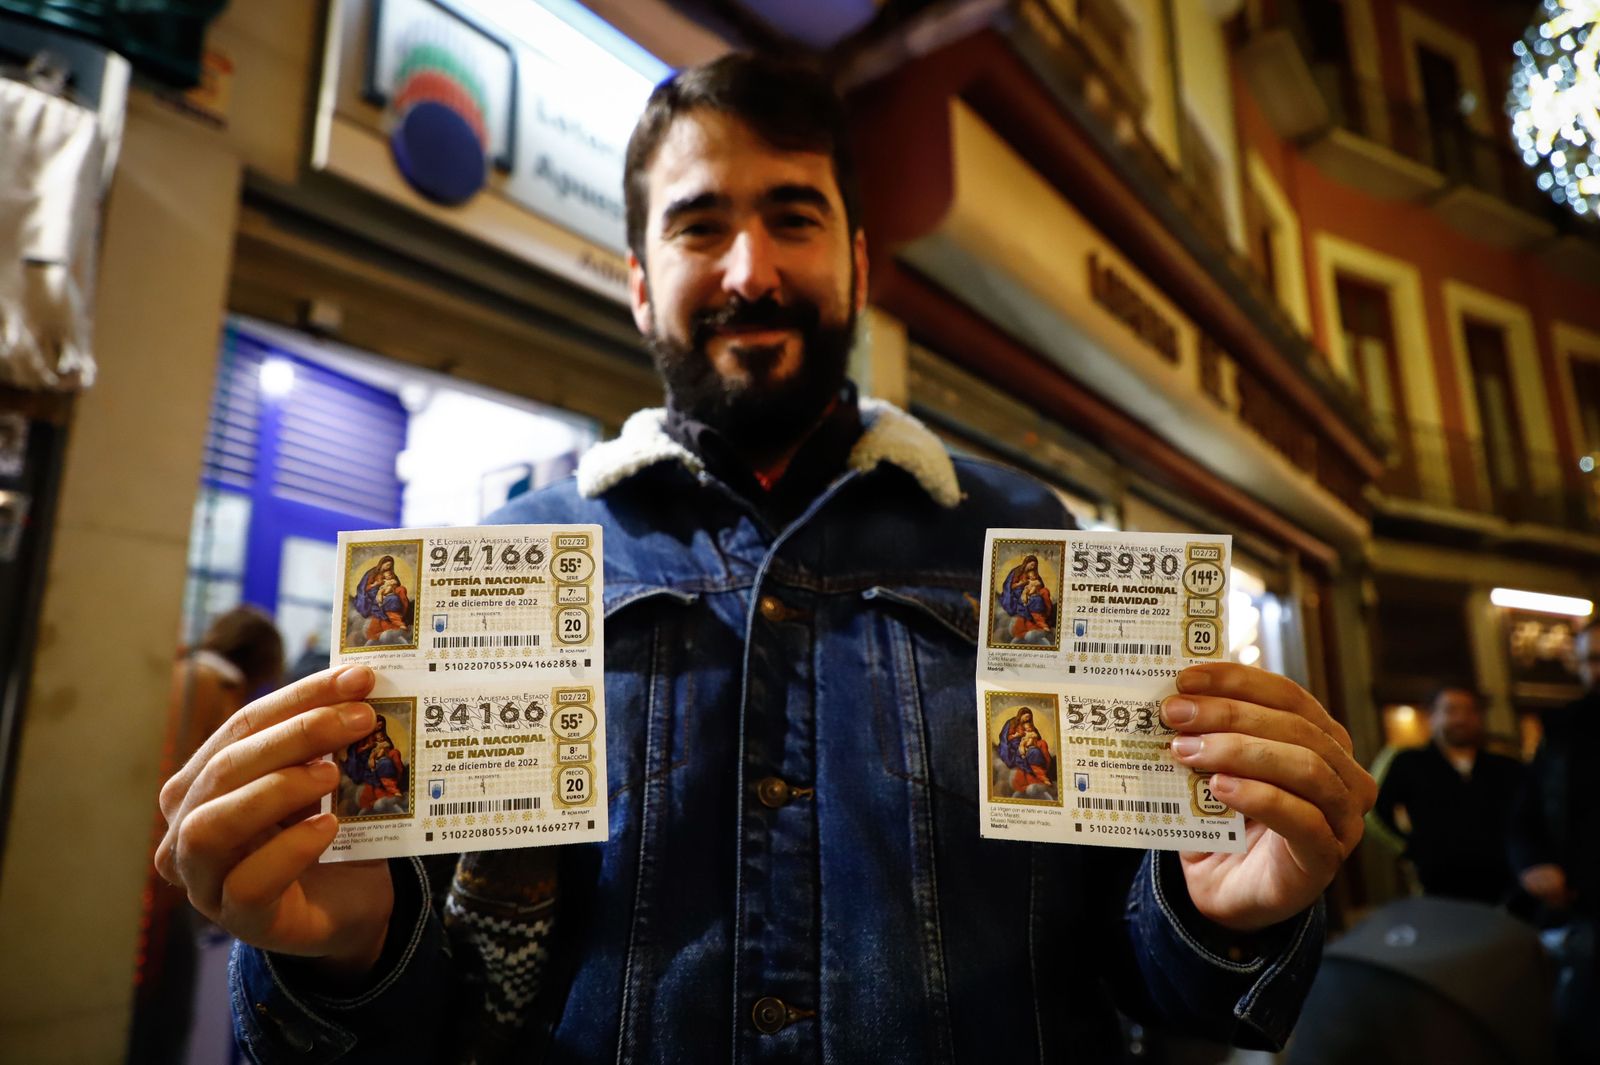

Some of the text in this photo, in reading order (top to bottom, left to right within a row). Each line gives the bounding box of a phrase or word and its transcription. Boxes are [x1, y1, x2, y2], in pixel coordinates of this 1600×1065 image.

[559, 538, 586, 546] 102/22
[430, 544, 545, 568] 94166
[1193, 549, 1217, 557] 102/22
[1072, 550, 1179, 576] 55930
[430, 575, 546, 587] LOTERÍA NACIONAL
[450, 587, 525, 598] DE NAVIDAD
[1071, 583, 1178, 595] LOTERÍA NACIONAL
[435, 598, 538, 608] 22 de diciembre de 2022
[1090, 595, 1159, 605] DE NAVIDAD
[1076, 605, 1170, 616] 22 de diciembre de 2022
[564, 619, 582, 632] 20
[1194, 631, 1211, 644] 20
[444, 659, 578, 671] 5102207055>0941662858
[560, 693, 587, 701] 102/22
[424, 701, 545, 728] 94166
[425, 734, 546, 748] LOTERÍA NACIONAL
[1068, 736, 1171, 751] LOTERÍA NACIONA
[447, 747, 525, 760] DE NAVIDAD
[1089, 749, 1160, 762] DE NAVIDAD
[431, 758, 539, 772] 22 de diciembre de 2022
[1076, 759, 1175, 773] 22 de diciembre de 2022
[566, 778, 584, 793] 20
[441, 822, 581, 840] 5102208055>0941669277
[1089, 824, 1221, 840] 5102202144>0559309869
